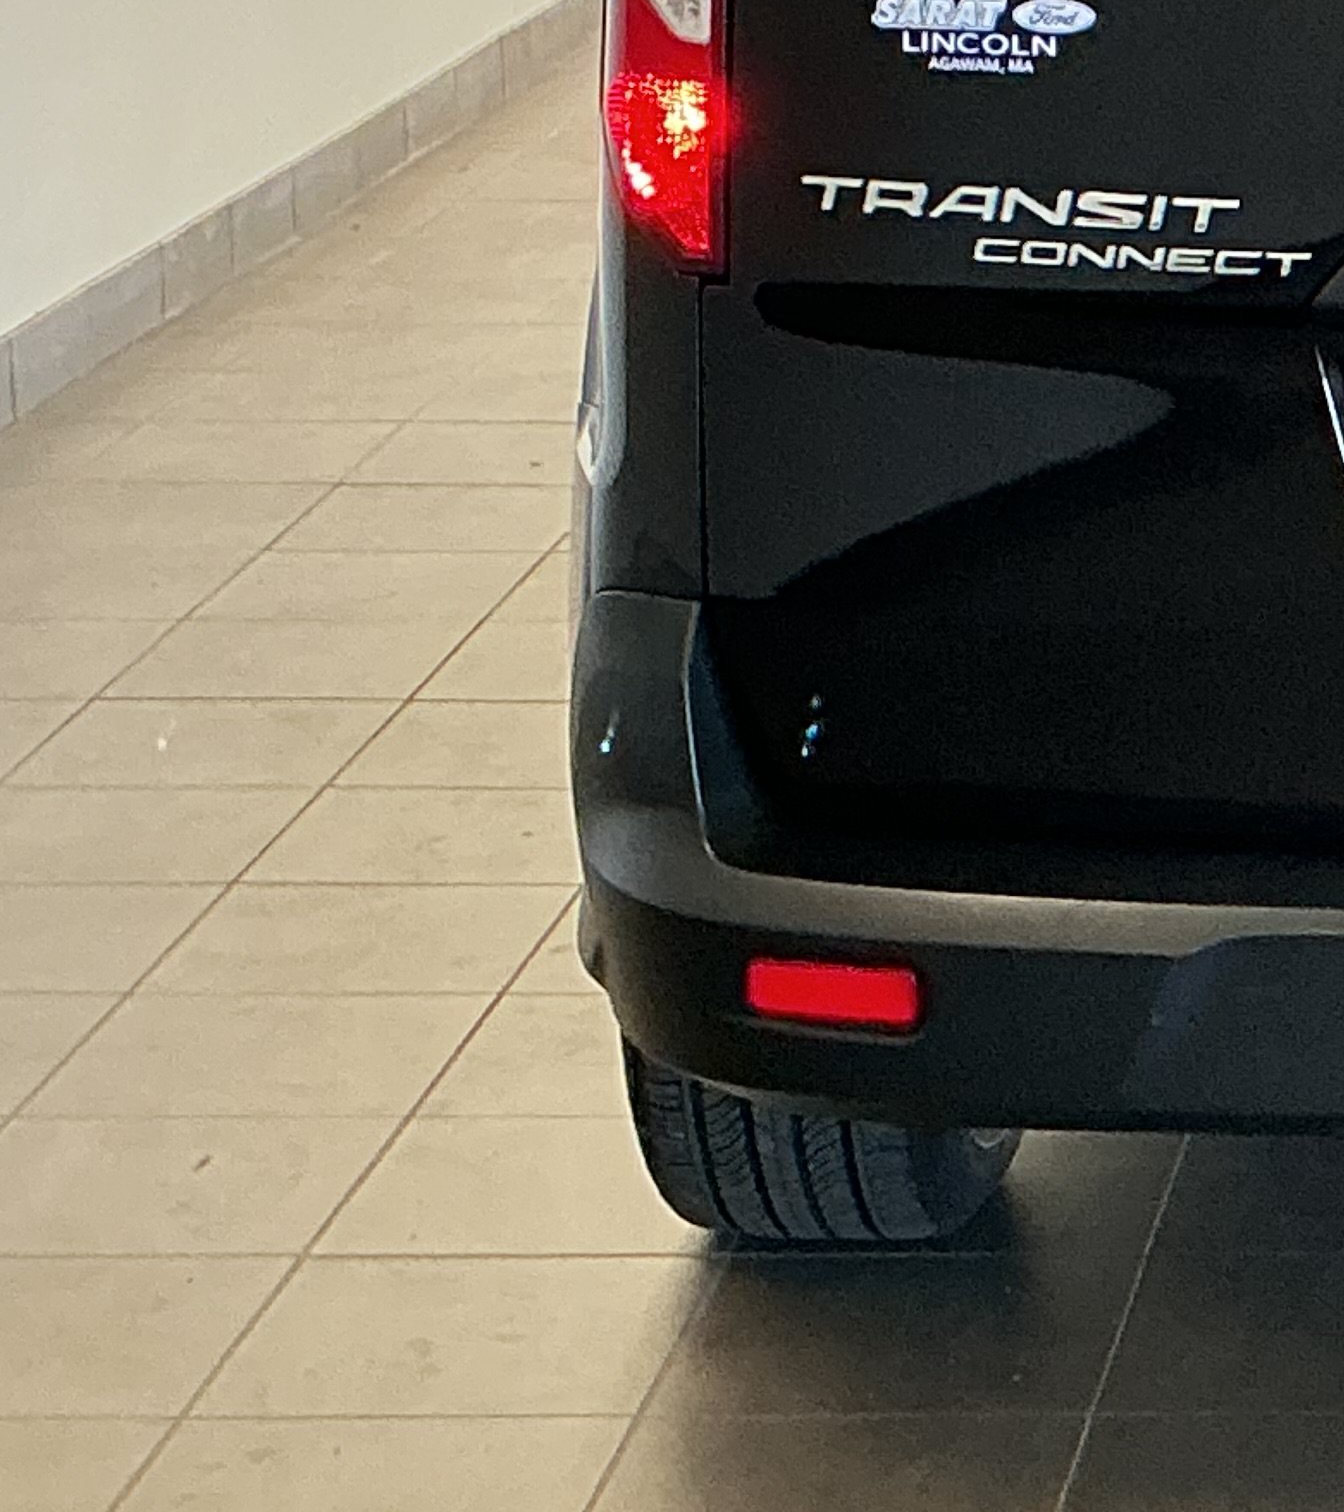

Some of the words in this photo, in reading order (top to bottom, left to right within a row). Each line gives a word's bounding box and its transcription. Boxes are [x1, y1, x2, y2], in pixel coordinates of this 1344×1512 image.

[902, 30, 1057, 58] LINCOLN
[1008, 57, 1034, 74] MA
[801, 175, 1241, 233] TRANSIT
[973, 238, 1313, 277] CONNECT
